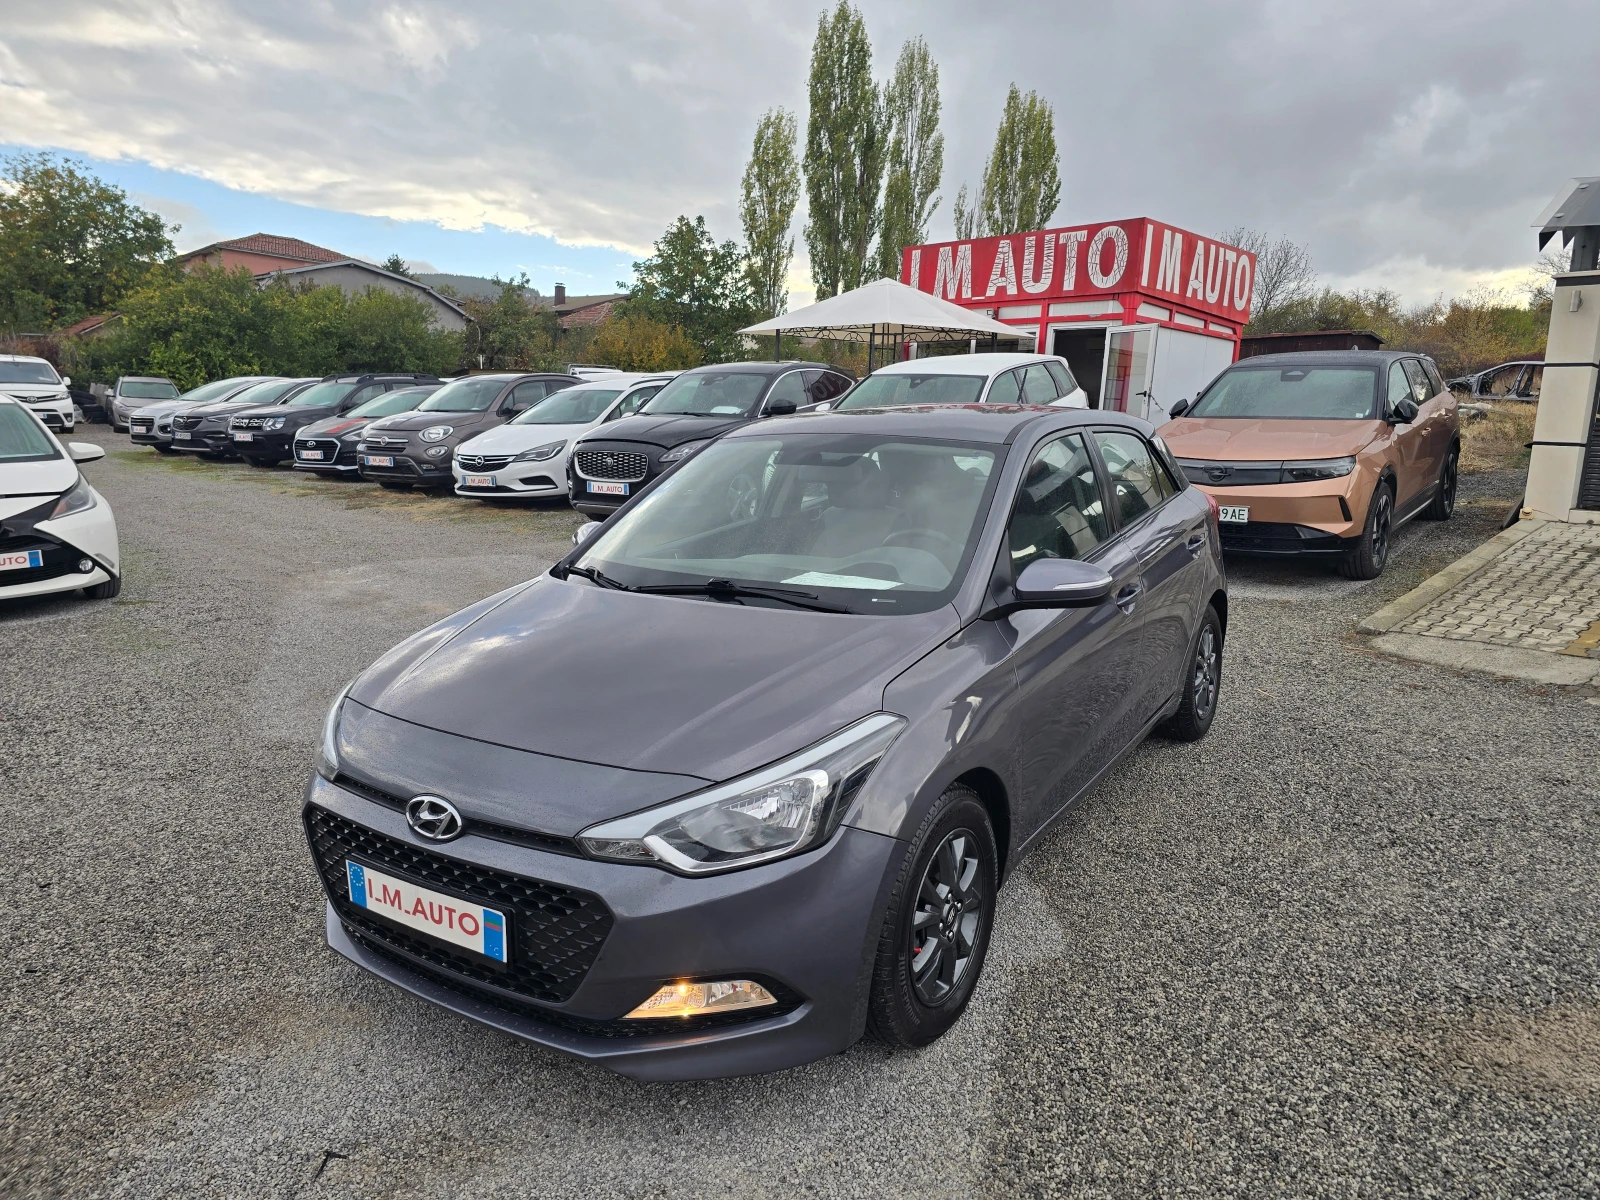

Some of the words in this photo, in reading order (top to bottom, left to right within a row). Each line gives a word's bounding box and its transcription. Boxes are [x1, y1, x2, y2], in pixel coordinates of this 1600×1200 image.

[910, 249, 921, 289] I
[1141, 224, 1153, 287] I
[1156, 229, 1183, 294] M
[1186, 240, 1251, 311] AUTO
[898, 952, 921, 1027] BRIDGESTONE
